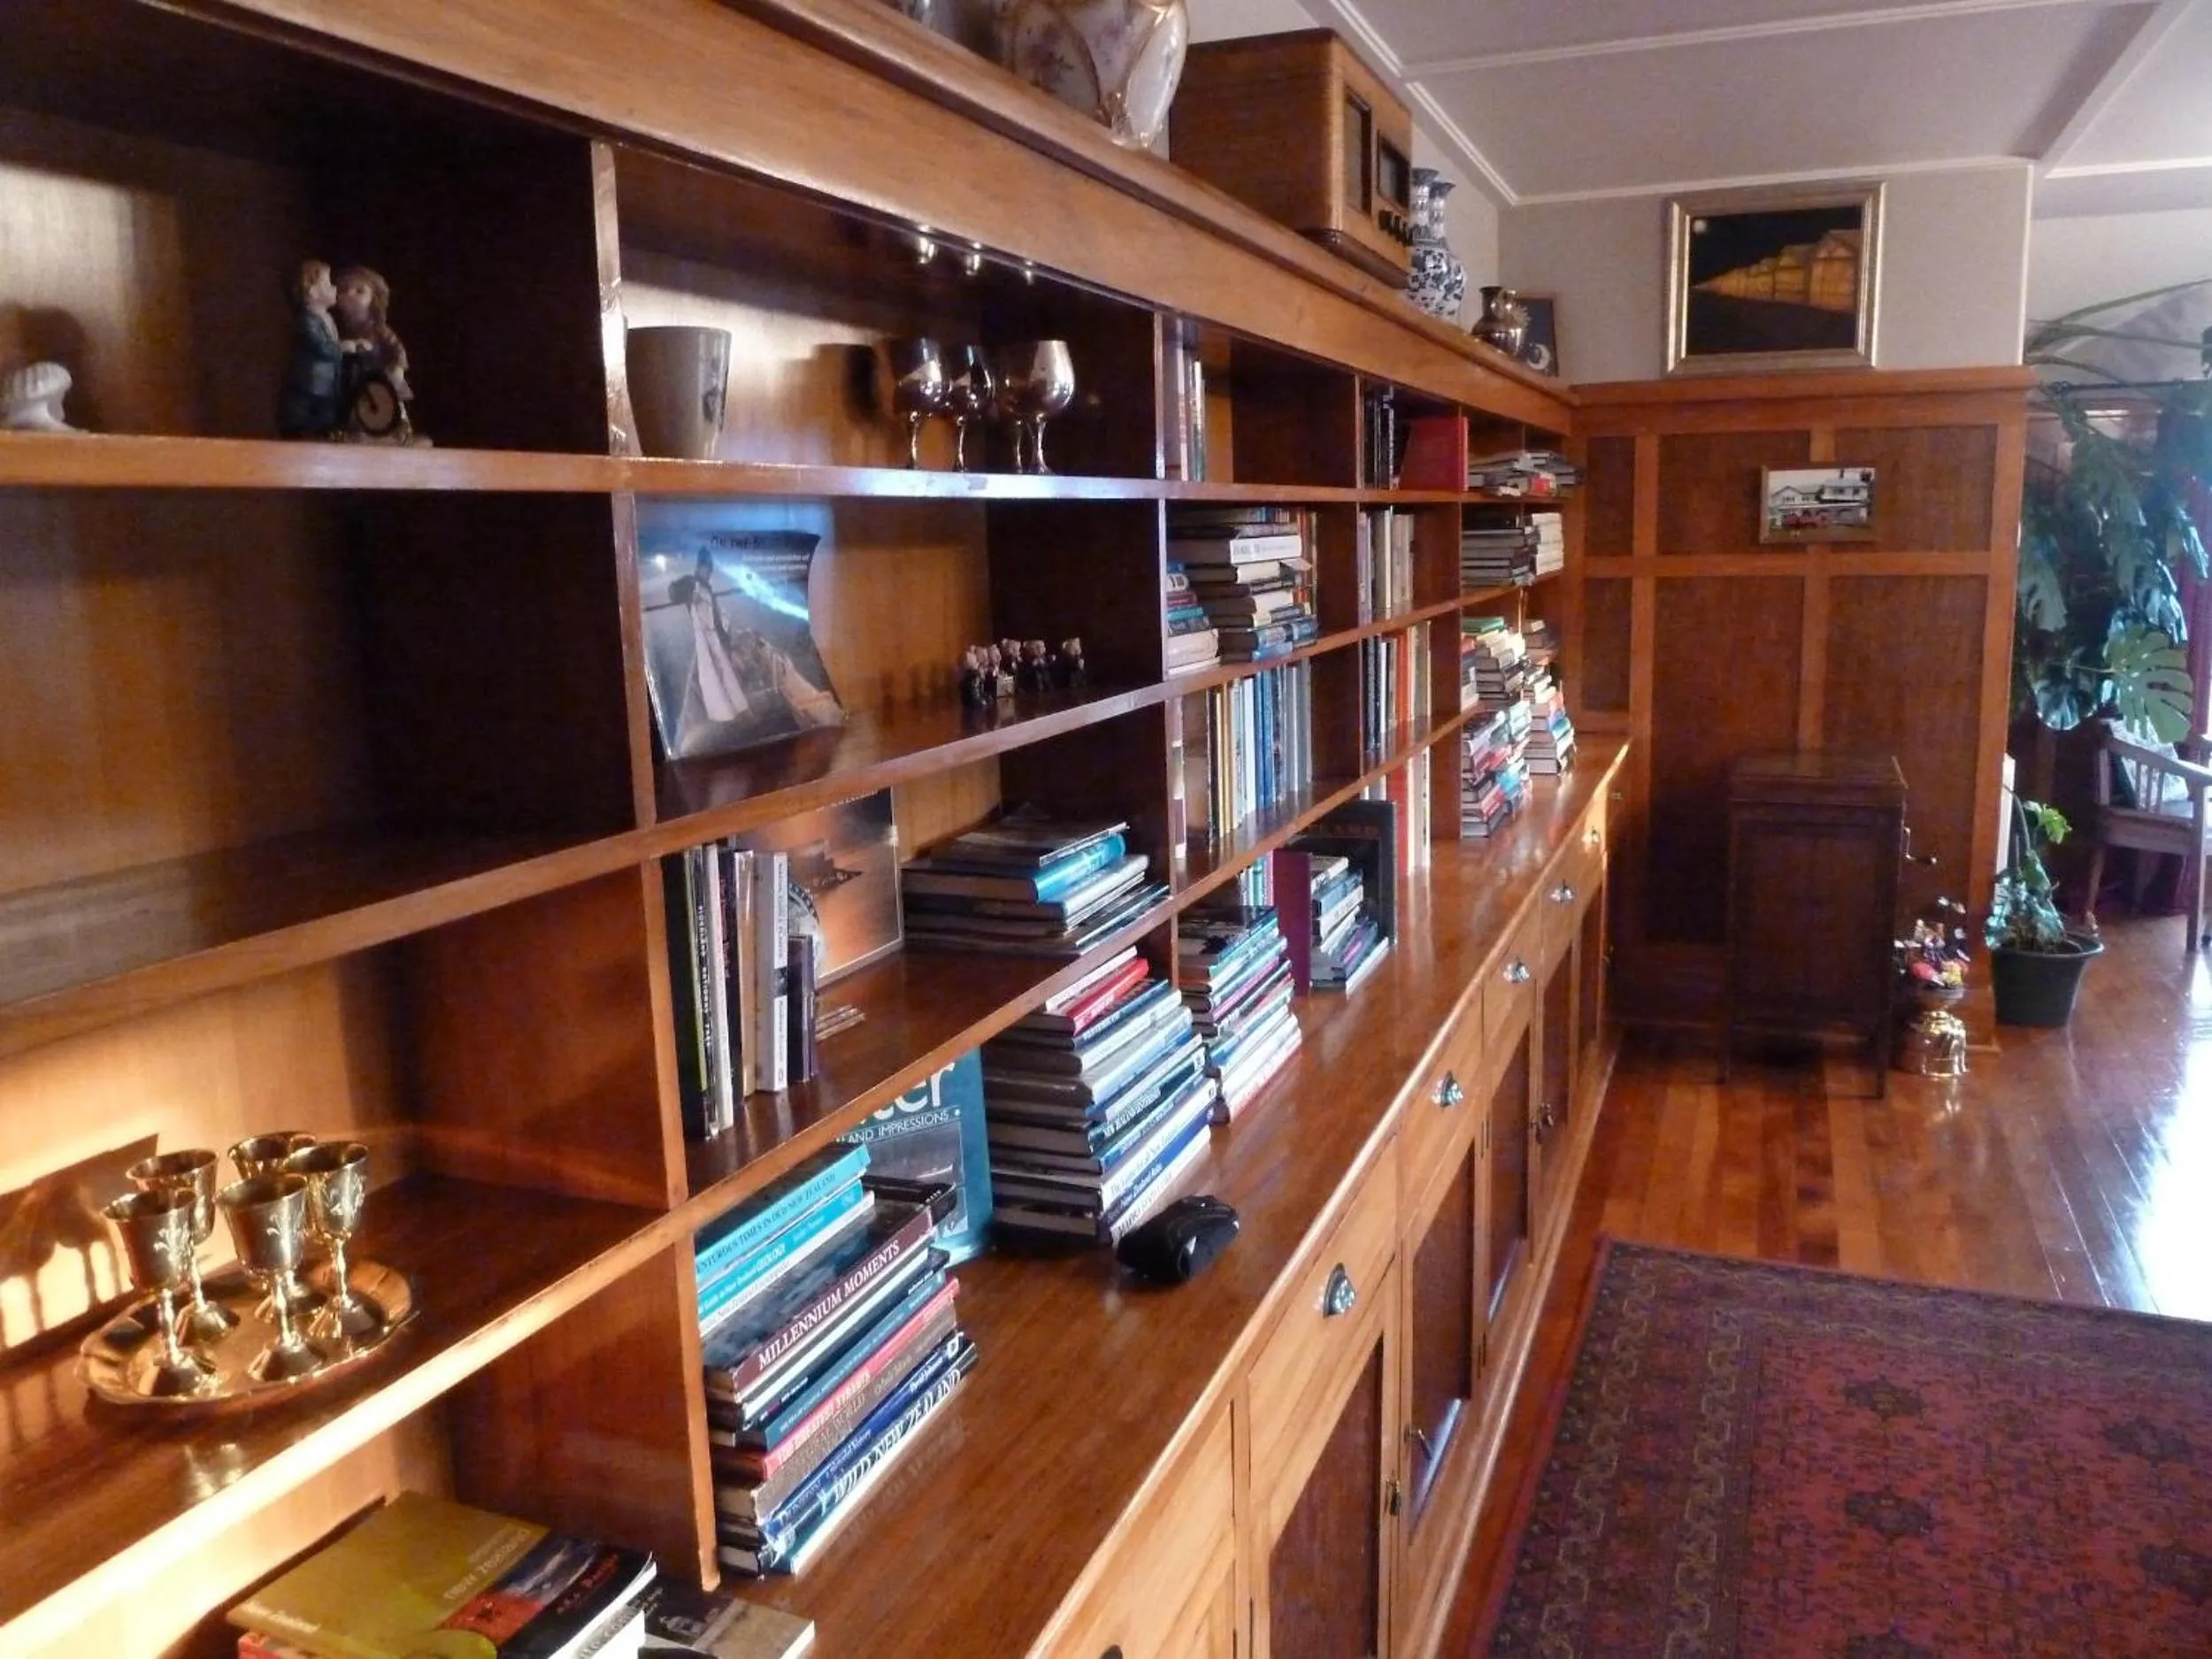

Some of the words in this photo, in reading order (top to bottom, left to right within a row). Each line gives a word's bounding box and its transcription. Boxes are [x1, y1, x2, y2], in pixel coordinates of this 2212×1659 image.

[849, 1128, 874, 1143] AND
[878, 1111, 949, 1137] IMPRESSIONS
[758, 1288, 842, 1371] MILLENNIUM
[843, 1239, 901, 1298] MOMENTS
[872, 1424, 907, 1461] NEW
[905, 1369, 962, 1430] ZEALAND
